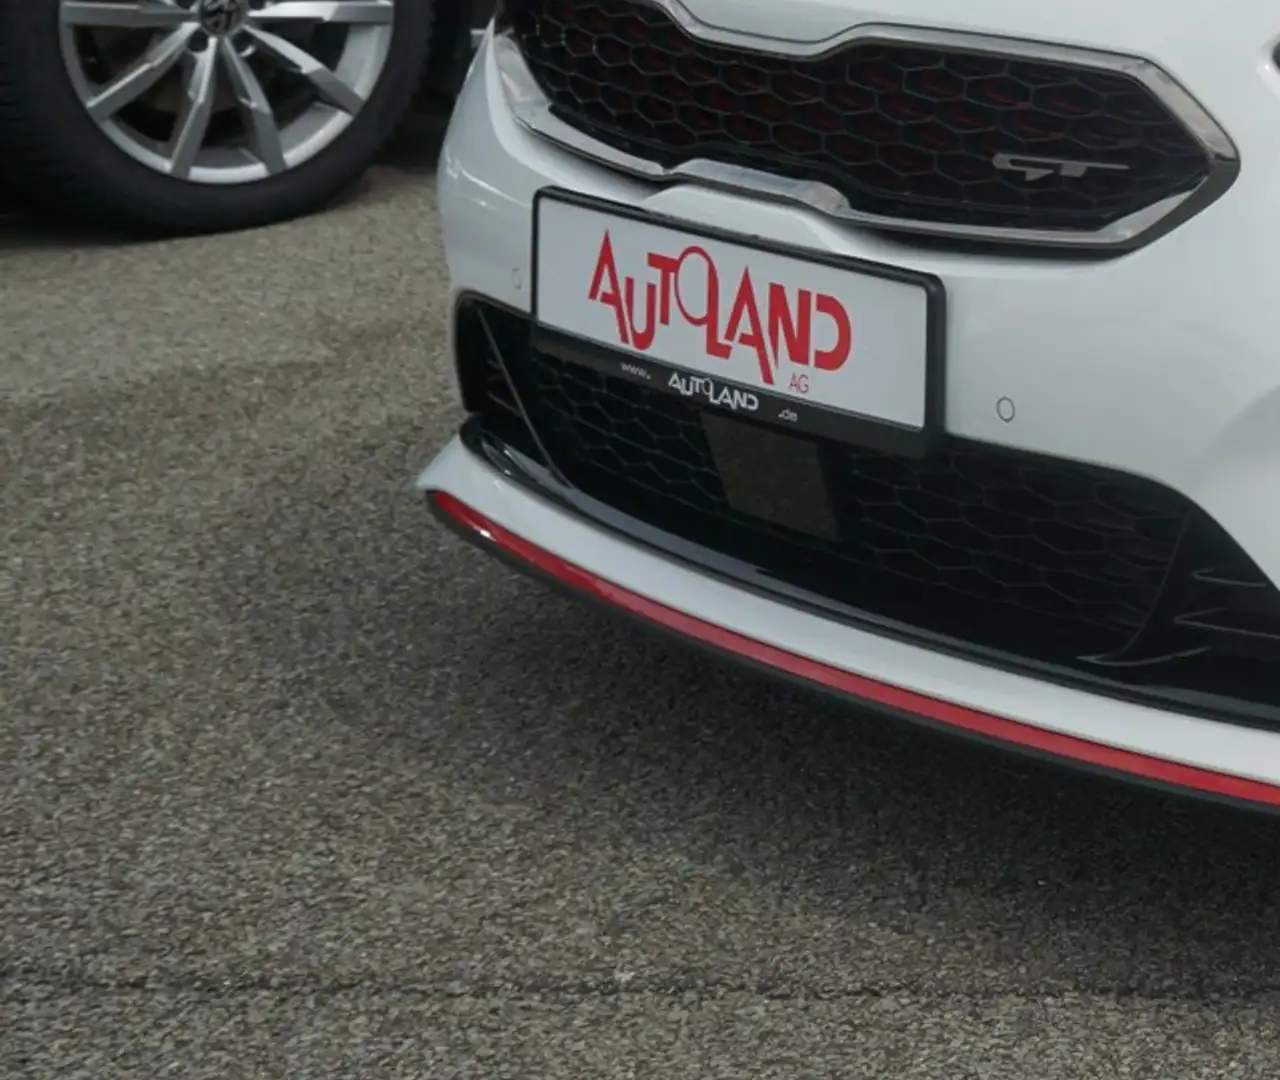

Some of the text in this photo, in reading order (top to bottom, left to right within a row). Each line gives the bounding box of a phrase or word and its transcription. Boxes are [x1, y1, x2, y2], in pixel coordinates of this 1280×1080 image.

[588, 228, 852, 386] AUTOLAND
[620, 362, 652, 380] www.
[668, 372, 760, 411] AUTOLAND
[787, 372, 810, 394] AG
